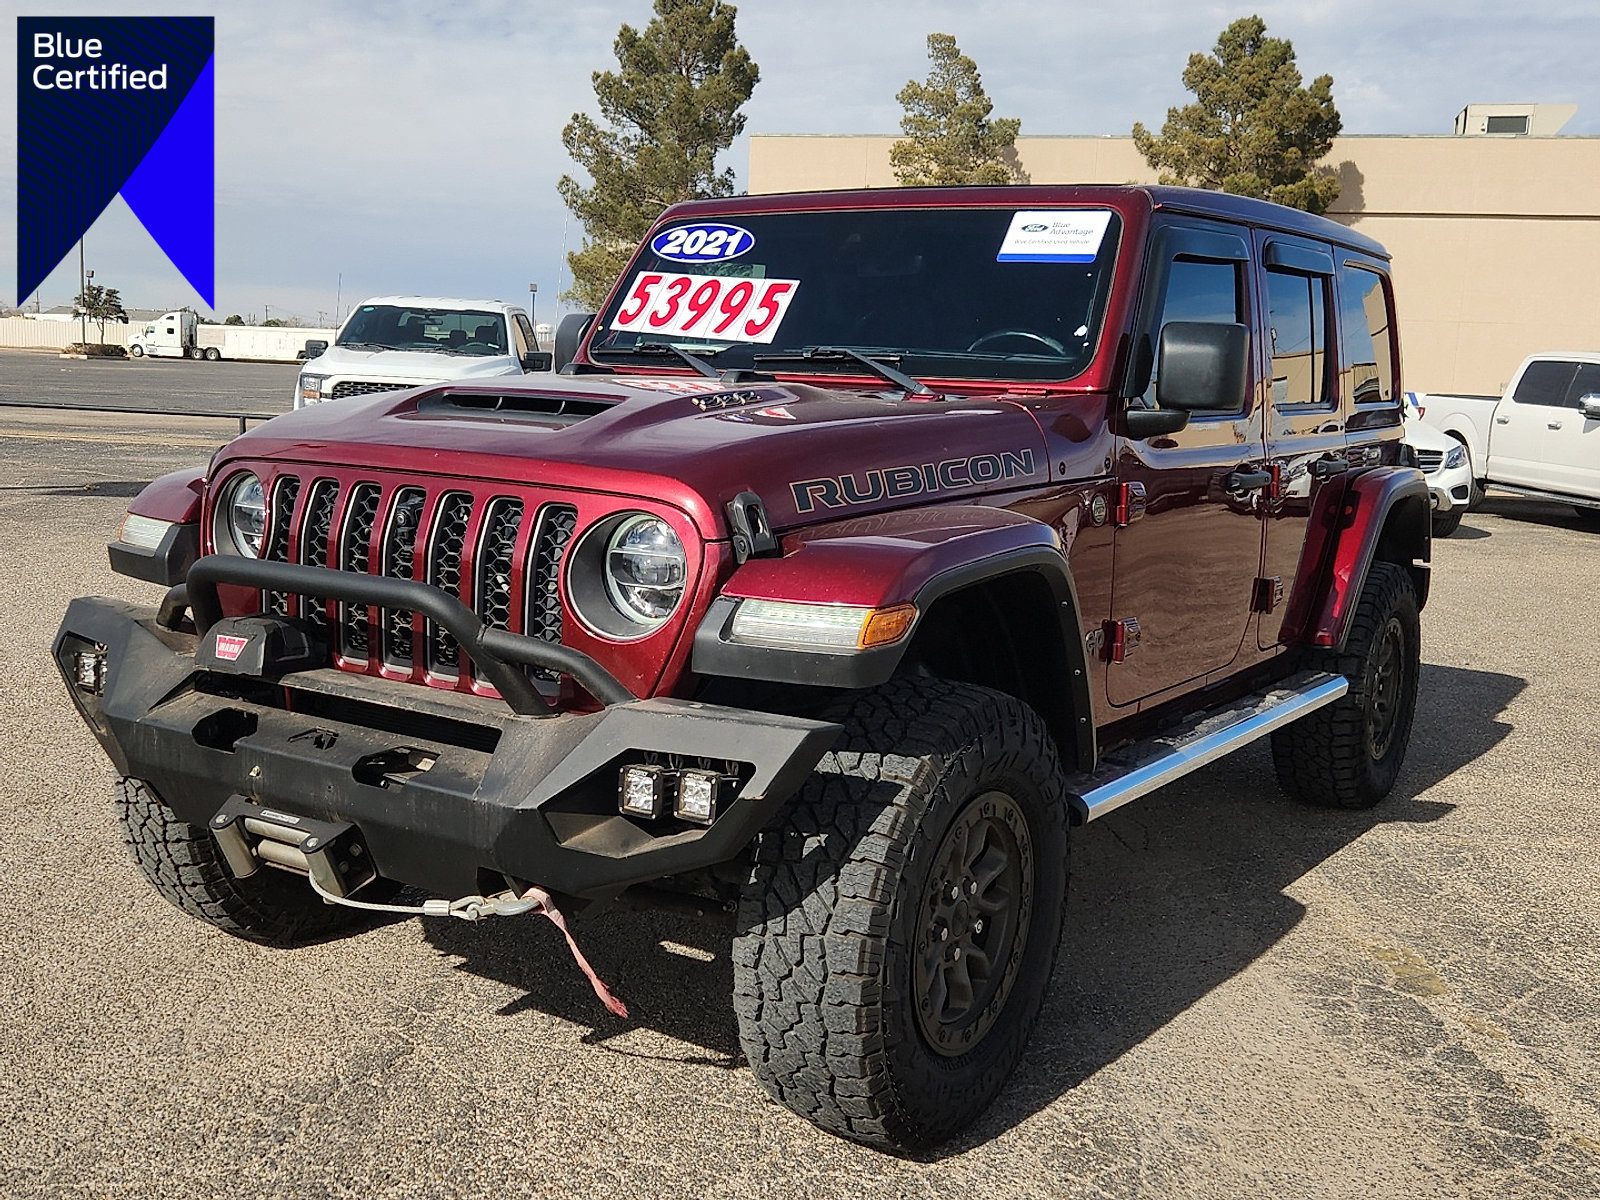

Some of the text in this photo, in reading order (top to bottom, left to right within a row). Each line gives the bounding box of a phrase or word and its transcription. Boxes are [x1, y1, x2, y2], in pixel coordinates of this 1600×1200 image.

[660, 229, 745, 256] 2021
[1049, 228, 1094, 236] Advantage
[618, 275, 794, 337] 53995
[789, 448, 1036, 514] RUBICON
